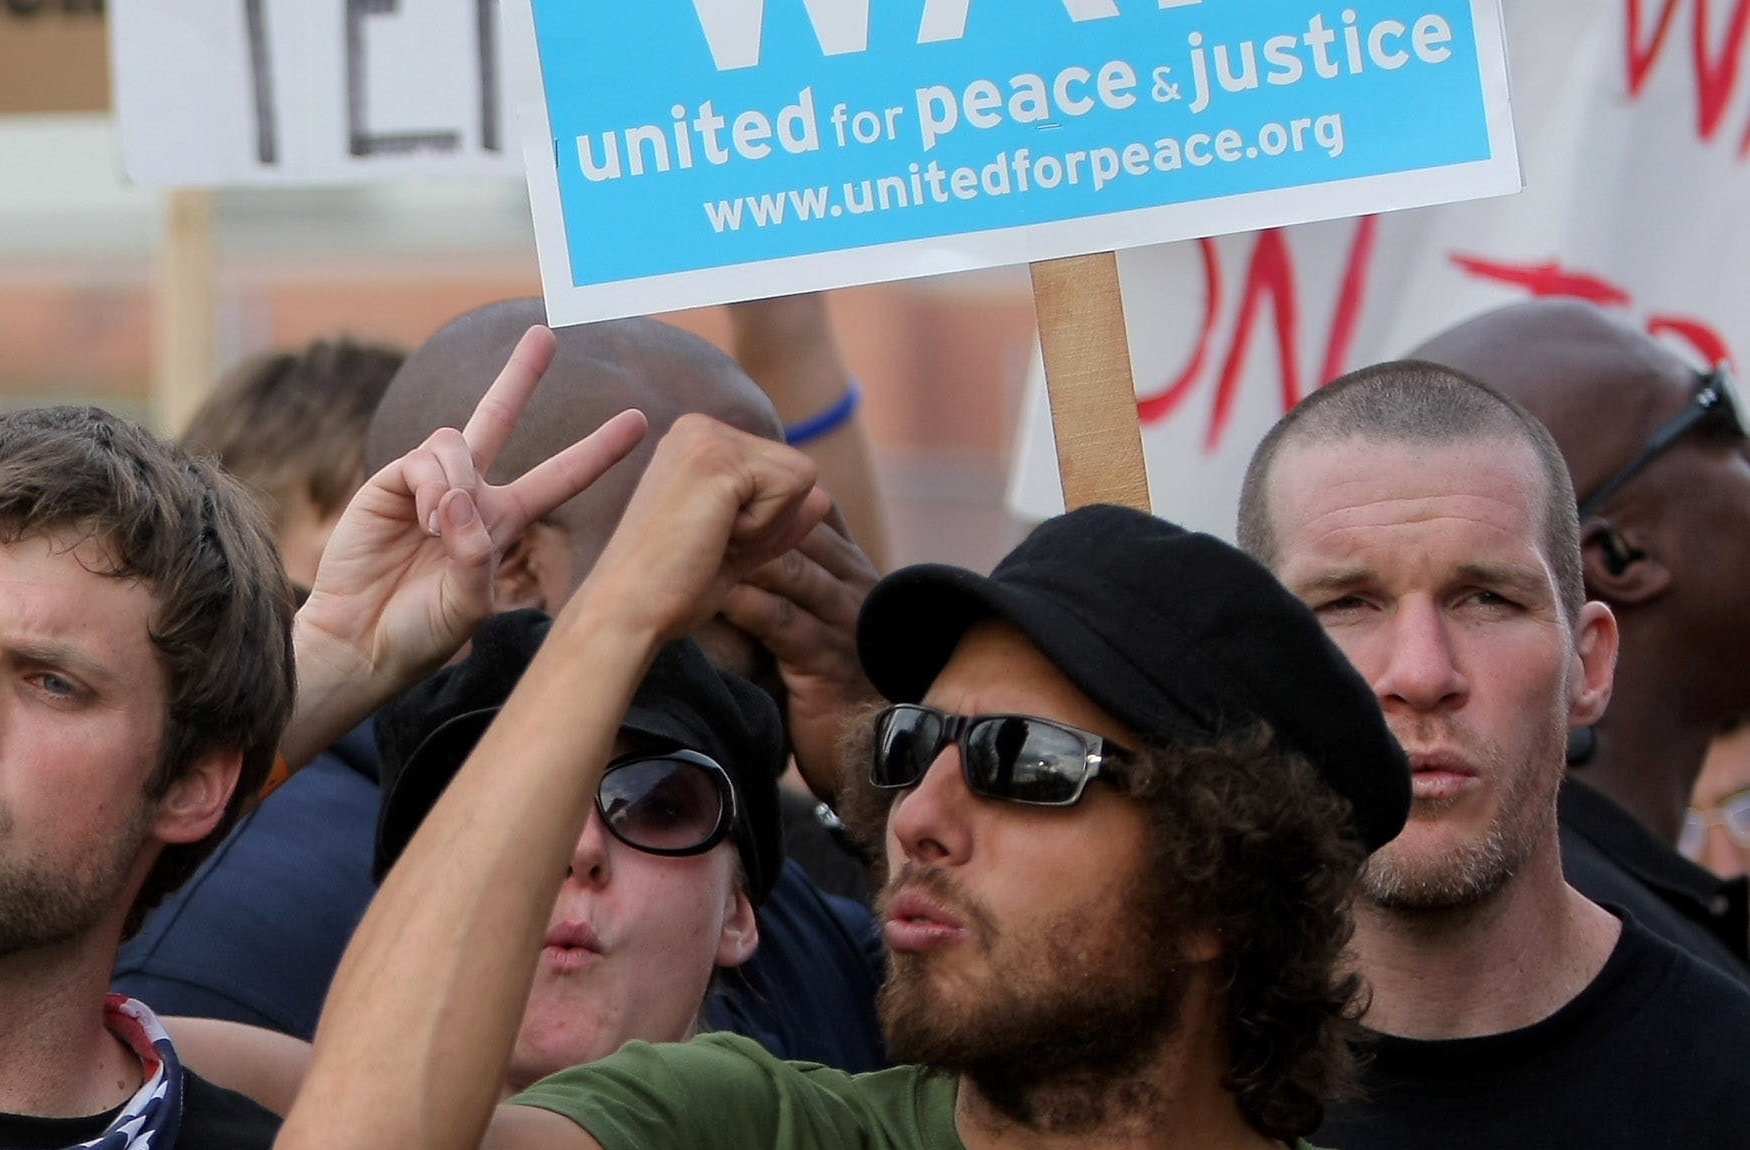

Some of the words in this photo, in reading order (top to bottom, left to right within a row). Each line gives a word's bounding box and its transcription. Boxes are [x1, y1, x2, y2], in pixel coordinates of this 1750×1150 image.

[575, 86, 820, 182] united
[830, 102, 903, 147] for
[914, 60, 1137, 152] peace
[1150, 65, 1181, 102] &
[1187, 8, 1453, 114] justice
[703, 113, 1345, 233] www.unitedforpeace.org
